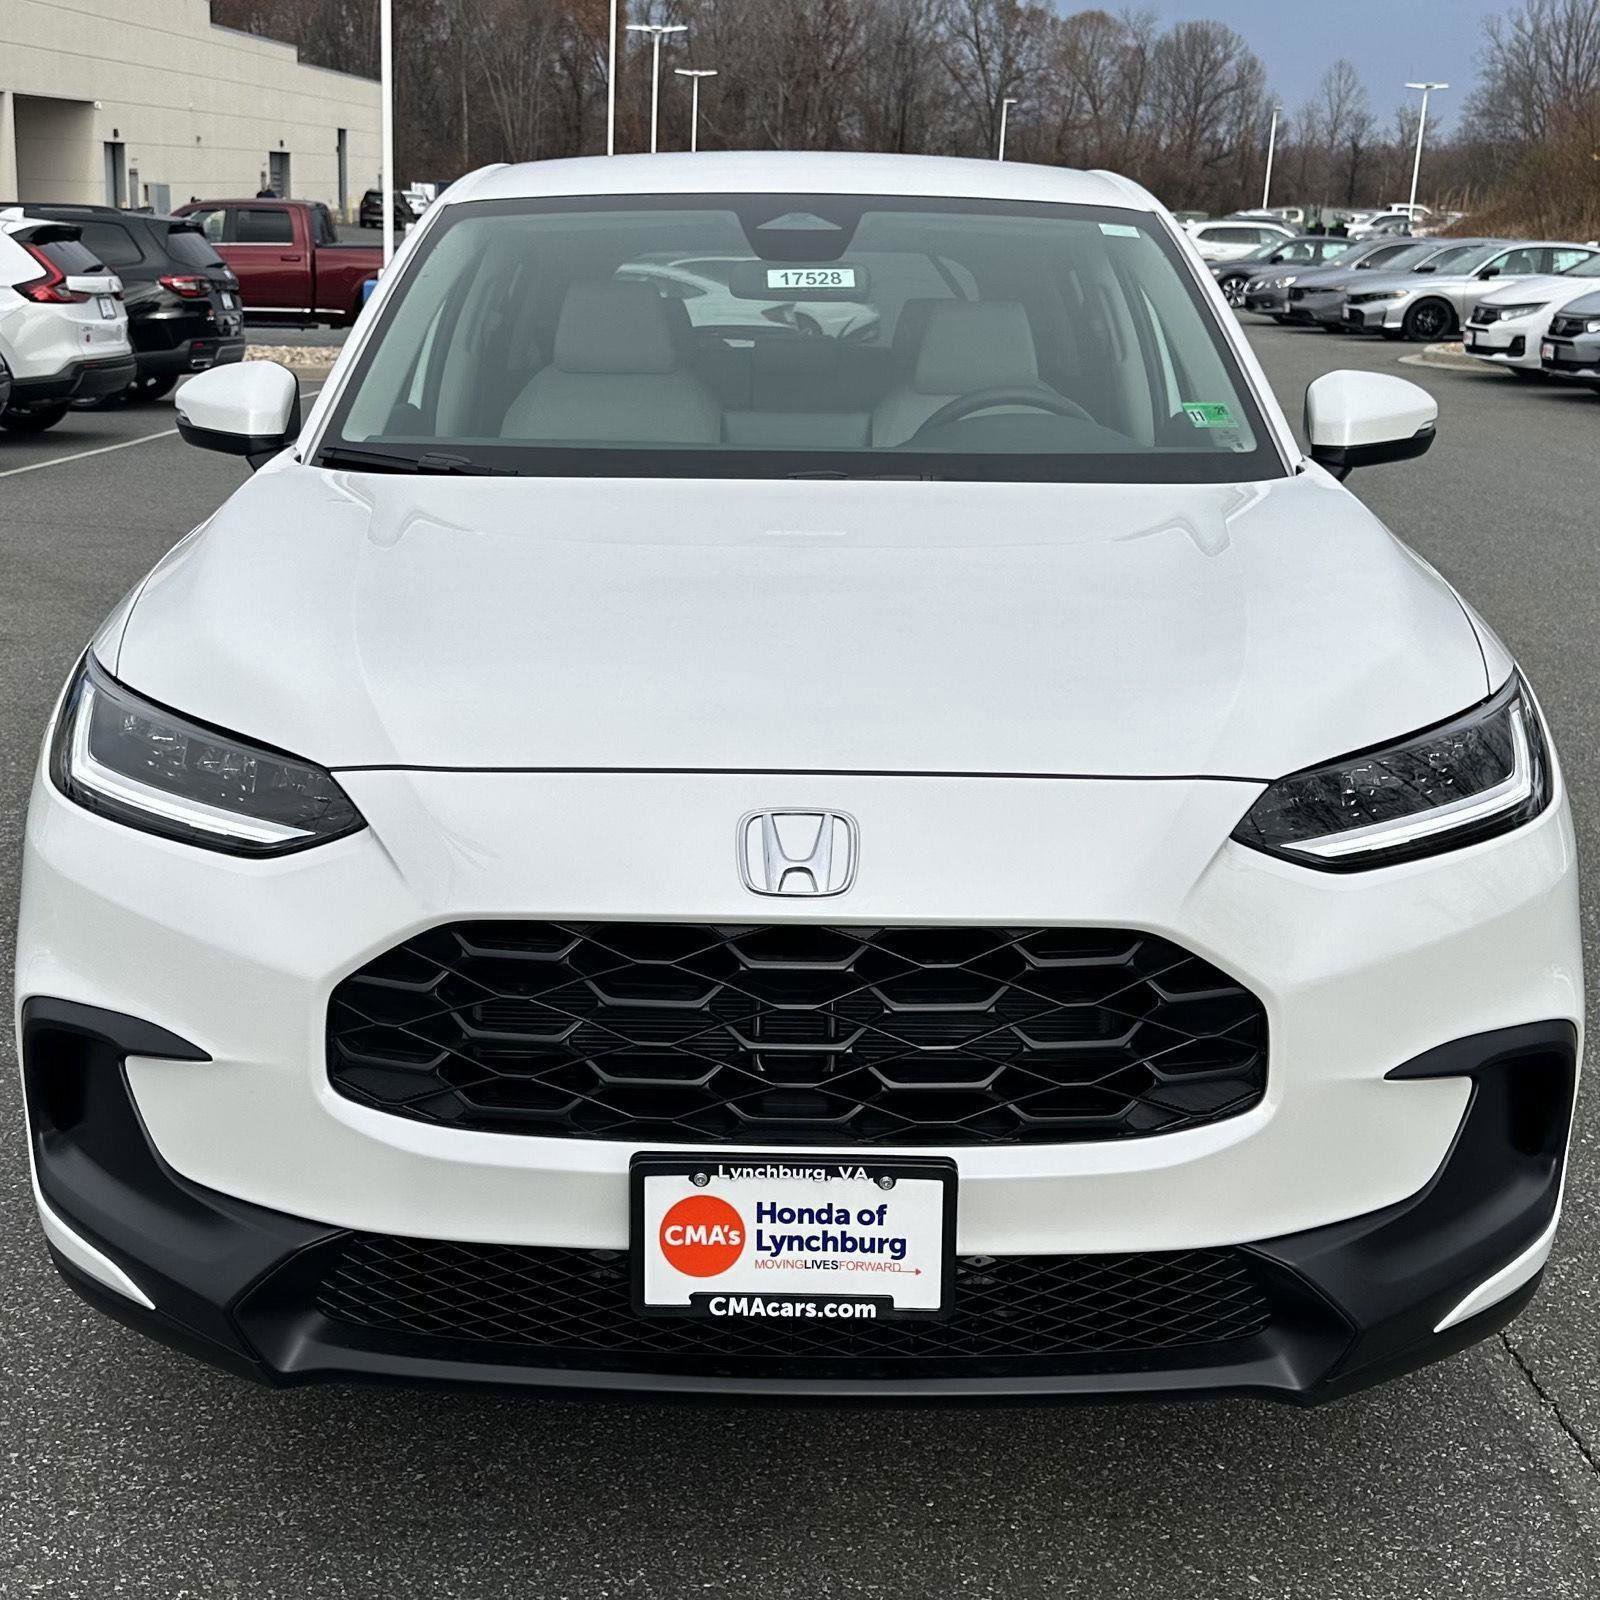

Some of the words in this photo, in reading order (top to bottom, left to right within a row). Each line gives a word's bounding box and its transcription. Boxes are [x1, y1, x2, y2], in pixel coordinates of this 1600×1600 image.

[780, 271, 842, 286] 17528
[1190, 410, 1206, 422] 11
[718, 1165, 832, 1182] Lynchburg,
[838, 1166, 868, 1180] VA
[756, 1202, 851, 1225] Honda
[856, 1204, 888, 1226] of
[664, 1224, 741, 1246] CMA's
[756, 1229, 907, 1260] Lynchburg
[708, 1296, 877, 1318] CMAcars.com
